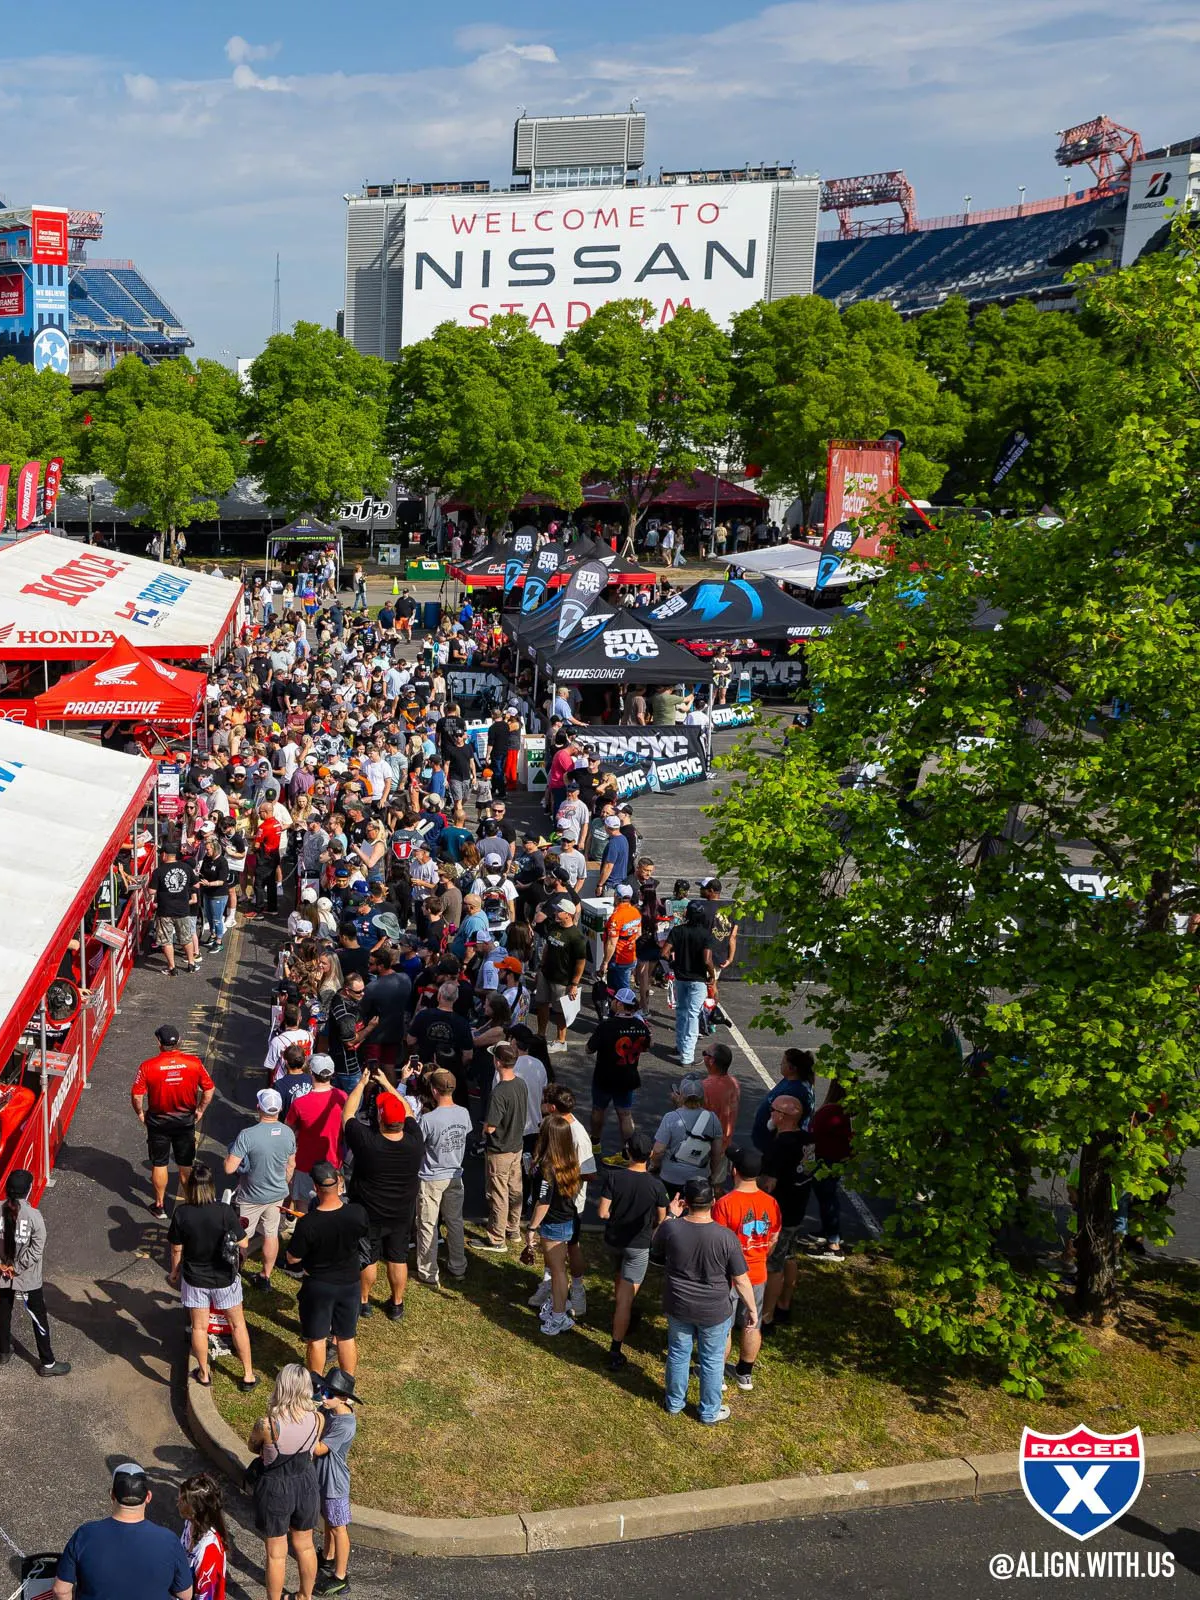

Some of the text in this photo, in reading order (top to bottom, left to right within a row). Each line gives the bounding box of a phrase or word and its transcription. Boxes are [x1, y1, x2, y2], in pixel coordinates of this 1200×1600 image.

[451, 202, 720, 235] WELCOME TO
[415, 239, 757, 291] NISSAN
[1, 291, 19, 299] Bureau
[466, 297, 695, 330] STADM
[515, 535, 532, 545] STA
[514, 543, 533, 552] CYC
[539, 551, 558, 563] STA
[537, 561, 558, 571] CYC
[578, 570, 600, 583] STA
[575, 581, 600, 593] CYC
[16, 630, 117, 644] HONDA
[603, 629, 654, 646] STA
[605, 643, 659, 659] CYC
[557, 668, 625, 679] #RIDESOONER
[63, 701, 161, 715] PROGRESSIVE
[657, 757, 702, 781] STACYC
[399, 843, 407, 857] 1
